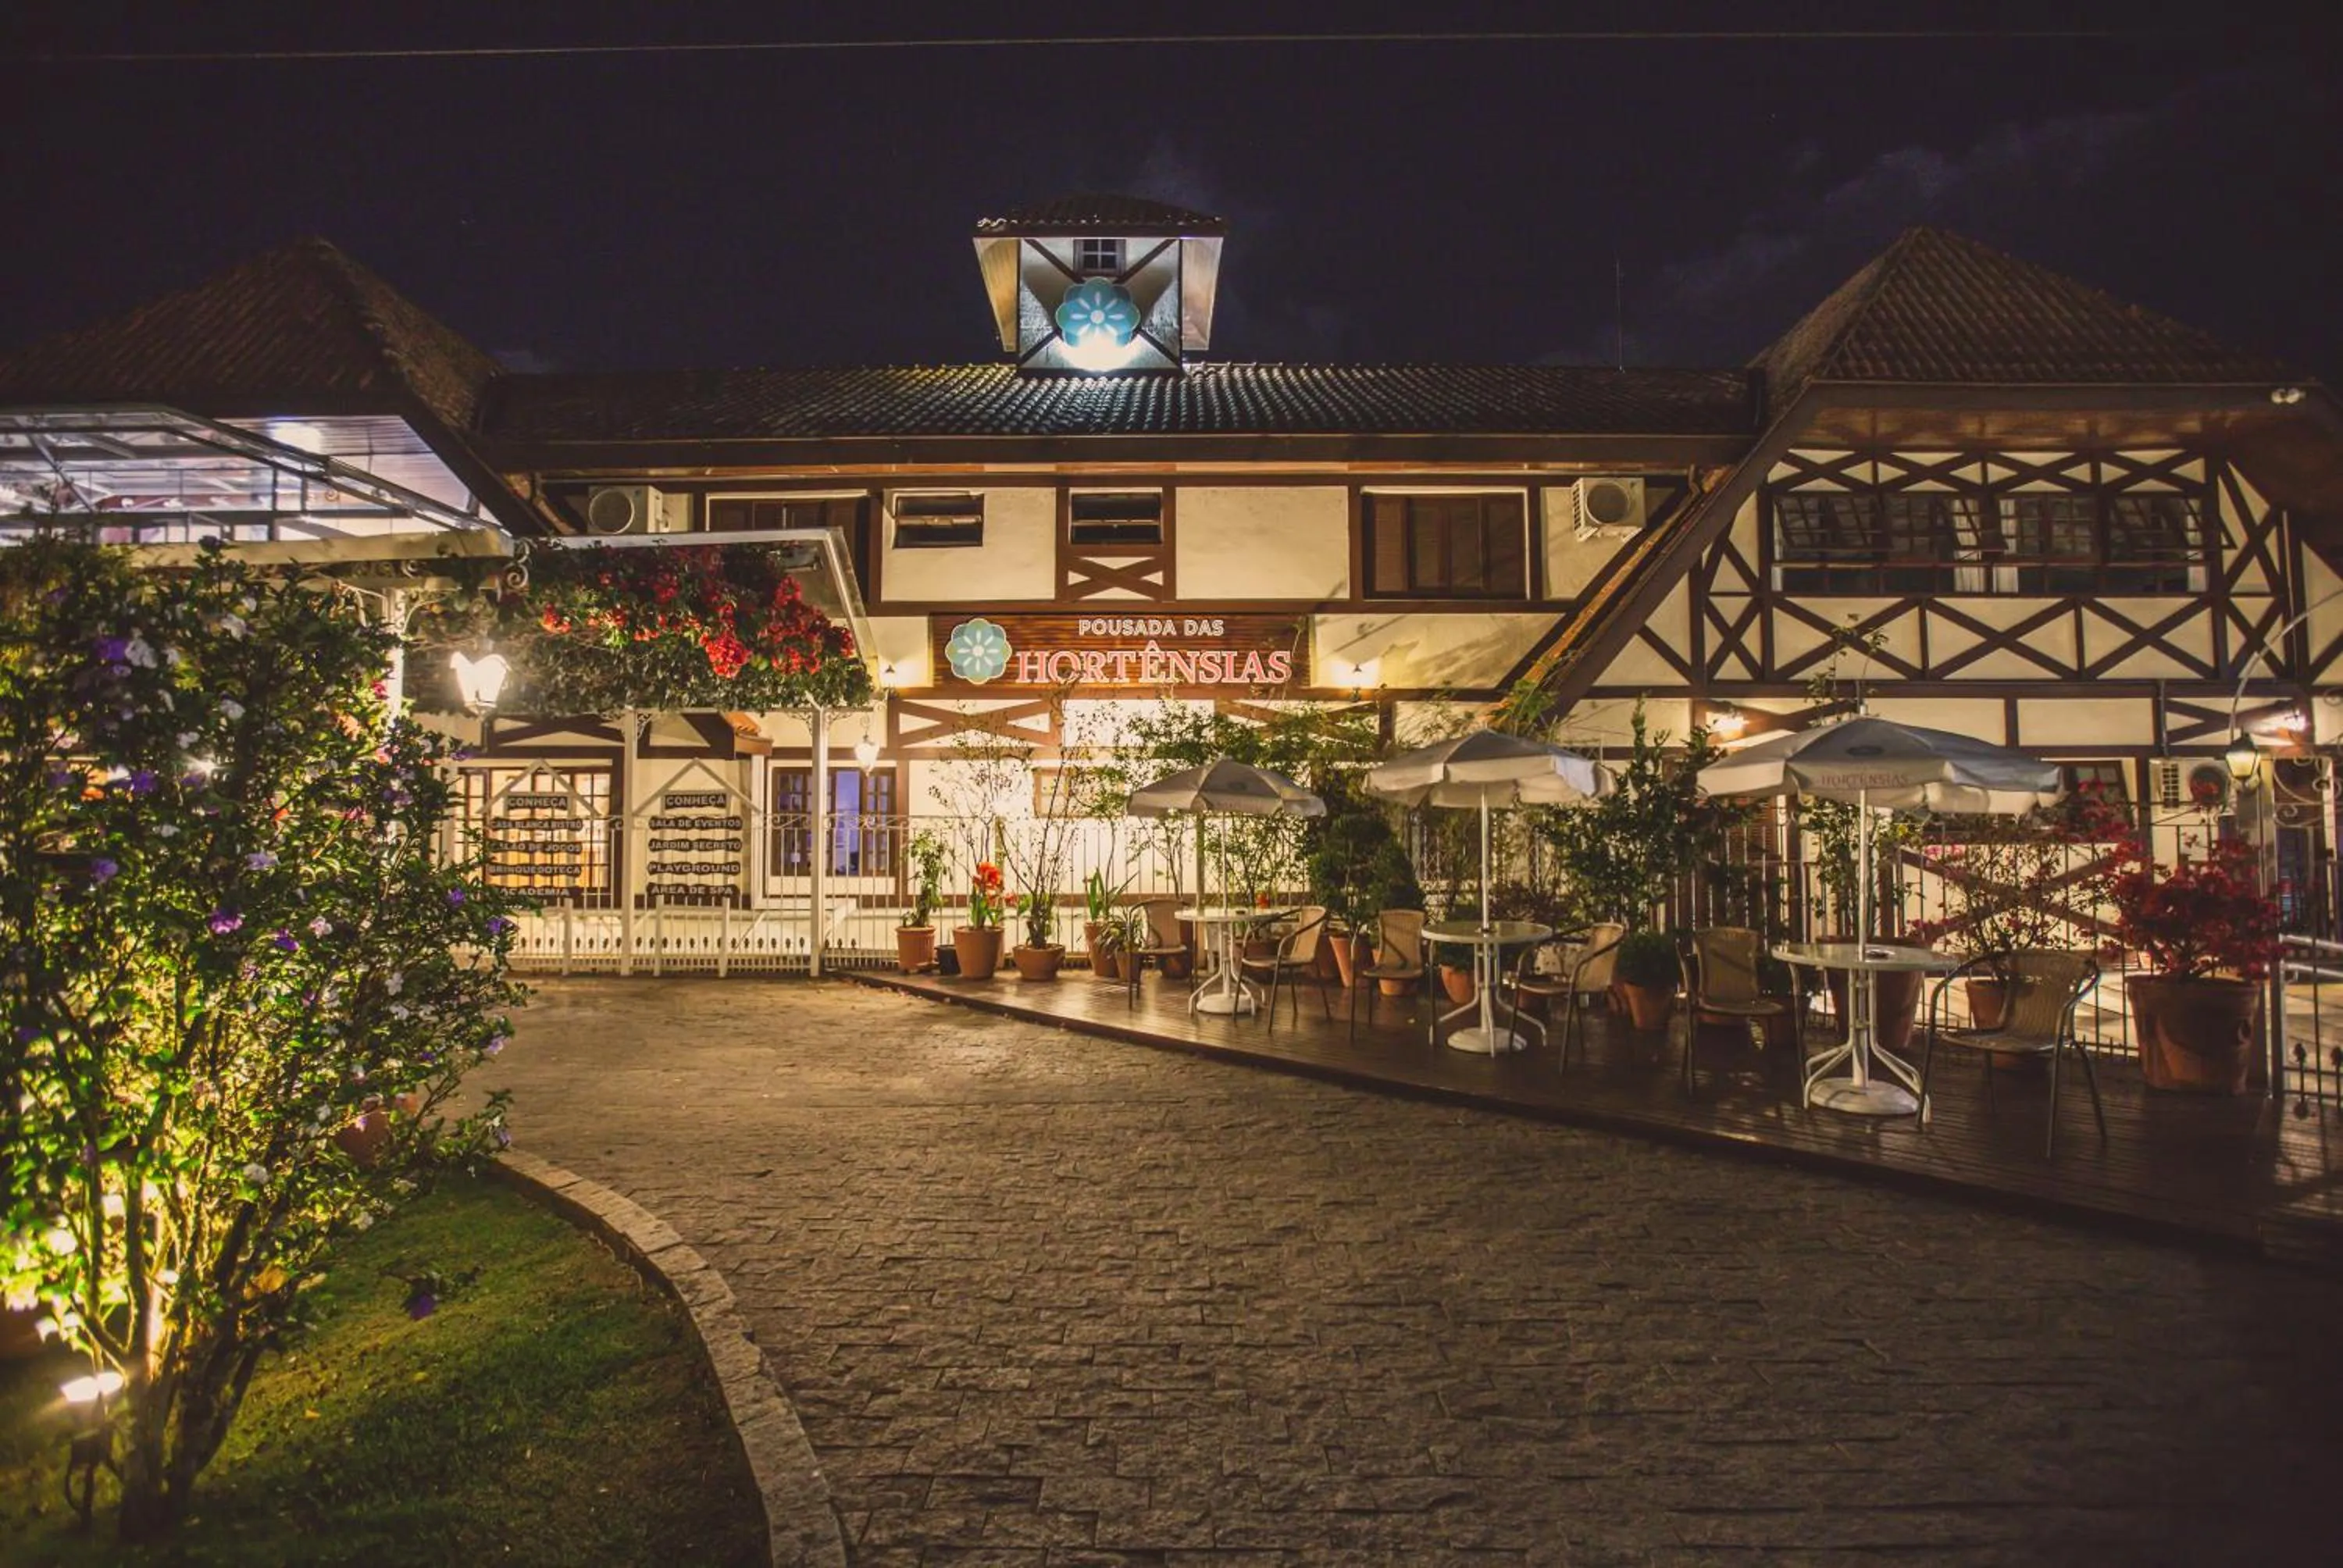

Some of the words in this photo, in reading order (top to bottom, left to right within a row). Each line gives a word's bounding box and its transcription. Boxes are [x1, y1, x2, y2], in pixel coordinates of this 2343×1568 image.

[1079, 618, 1176, 636] POUSADA
[1184, 619, 1224, 636] DAS
[1015, 640, 1292, 684] HORTÊNSIAS
[508, 796, 566, 807] CONHEÇA
[666, 795, 726, 806] CONHEÇA
[651, 819, 676, 828] SALA
[678, 818, 692, 828] DE
[694, 819, 741, 828] EVENTOS
[528, 843, 543, 851] DE
[544, 843, 580, 852] JOGOS
[650, 840, 690, 850] JARDIM
[692, 840, 741, 850] SECRETO
[649, 863, 740, 873] PLAYGROUND
[499, 886, 570, 896] ACADEMIA
